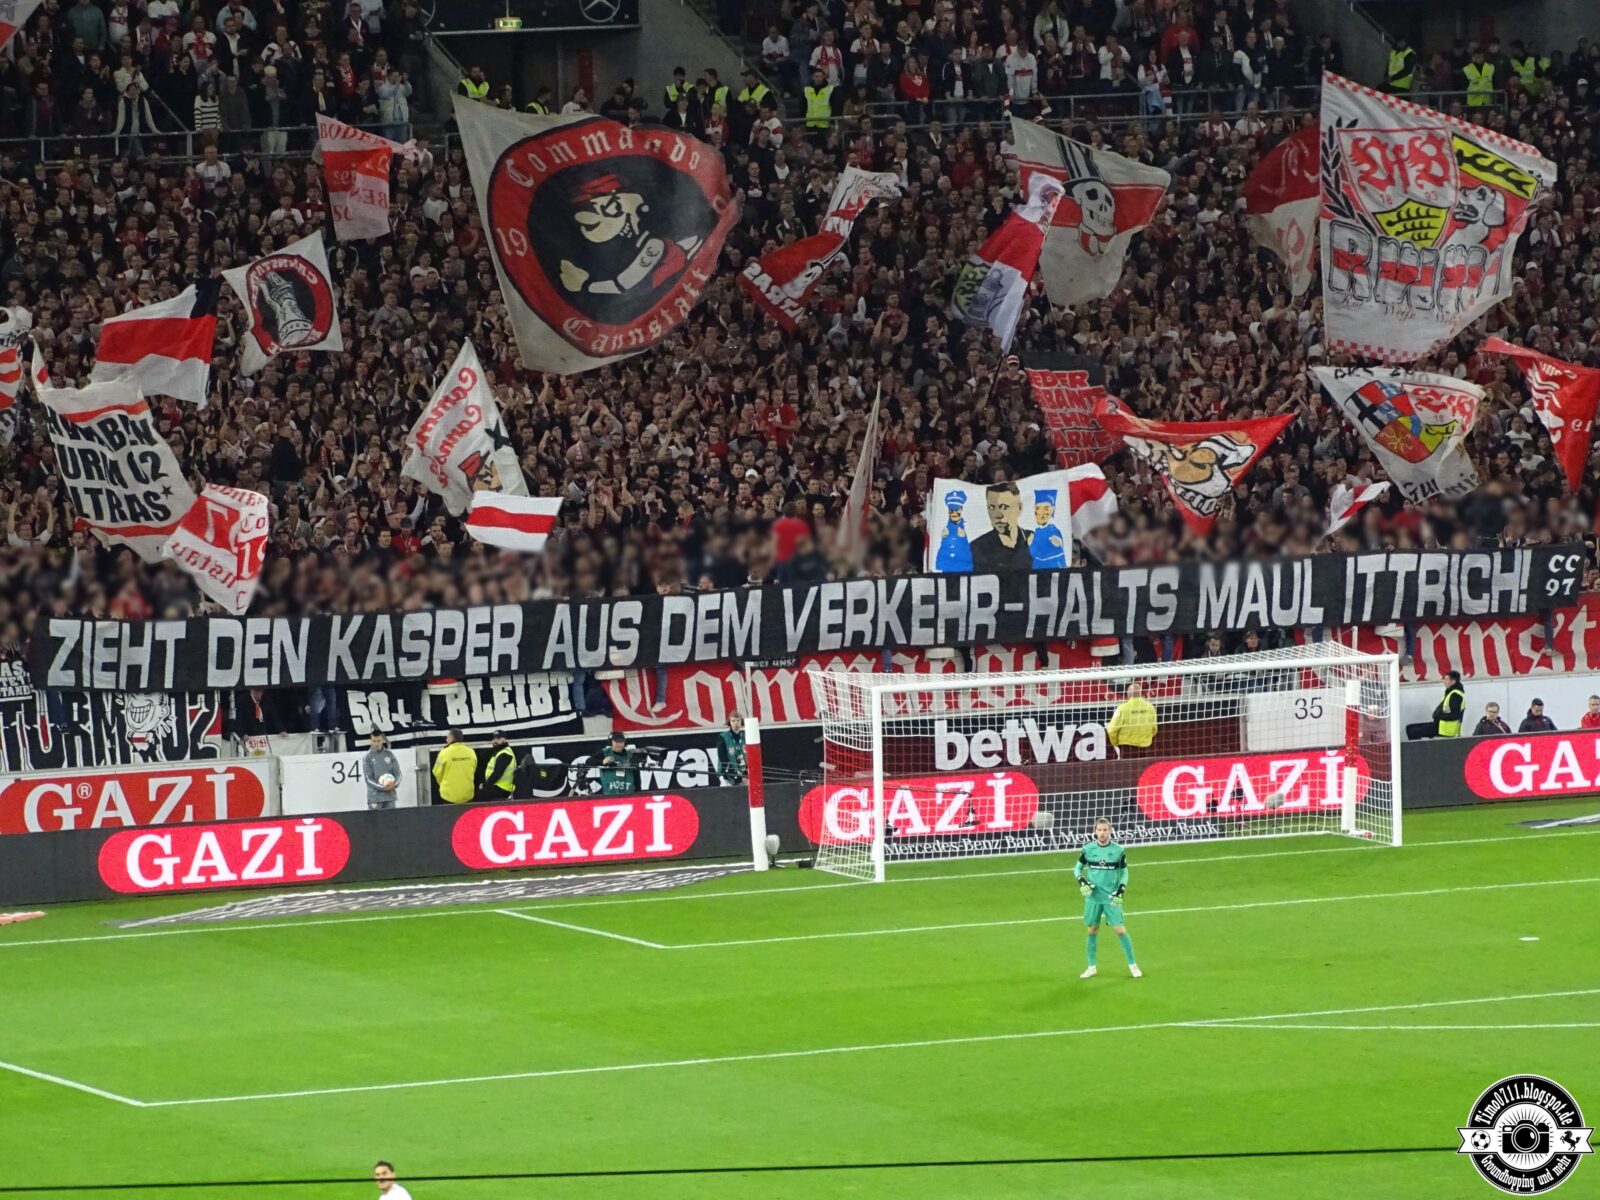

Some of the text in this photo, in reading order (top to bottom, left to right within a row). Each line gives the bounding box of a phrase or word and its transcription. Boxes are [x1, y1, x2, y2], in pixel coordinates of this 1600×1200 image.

[505, 127, 701, 188] Commando
[496, 226, 529, 257] 19
[562, 266, 709, 352] Cannstatt
[1545, 577, 1576, 596] 97
[1548, 554, 1581, 573] CC
[47, 549, 1532, 688] ZIEHT DEN KASPER AUS DEM VERKEHR-HALTS MAUL ITTRICH!
[445, 671, 575, 726] BLEIBT
[1294, 696, 1324, 720] 35
[933, 716, 1108, 771] betwa
[1489, 740, 1600, 794] GA
[330, 760, 363, 785] 34
[609, 780, 632, 791] HOST
[125, 818, 325, 889] GAZİ
[478, 795, 674, 865] GAZİ
[883, 837, 1001, 856] Mercedes-Benz
[1005, 830, 1047, 849] Bank
[1179, 820, 1219, 837] Bank
